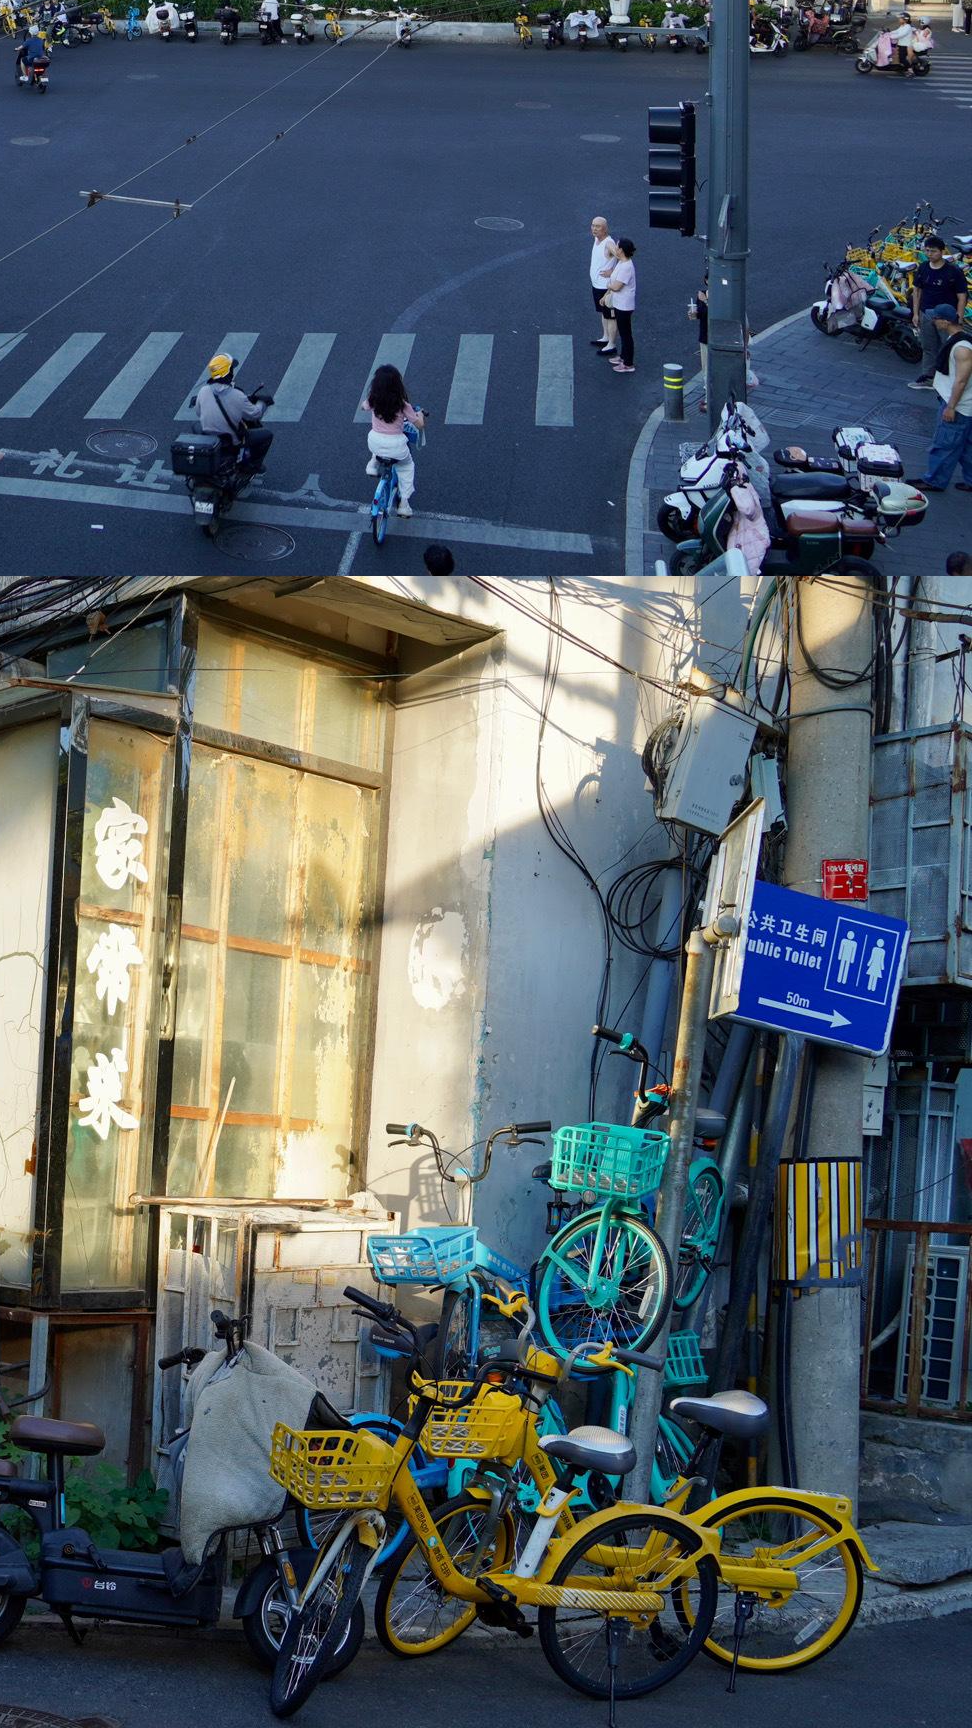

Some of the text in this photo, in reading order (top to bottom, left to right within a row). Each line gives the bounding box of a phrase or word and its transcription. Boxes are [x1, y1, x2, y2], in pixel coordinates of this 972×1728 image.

[748, 910, 827, 948] 公共卫生间
[78, 796, 149, 1140] 家常菜
[746, 936, 822, 970] ublic Toilet
[785, 991, 810, 1008] 50m
